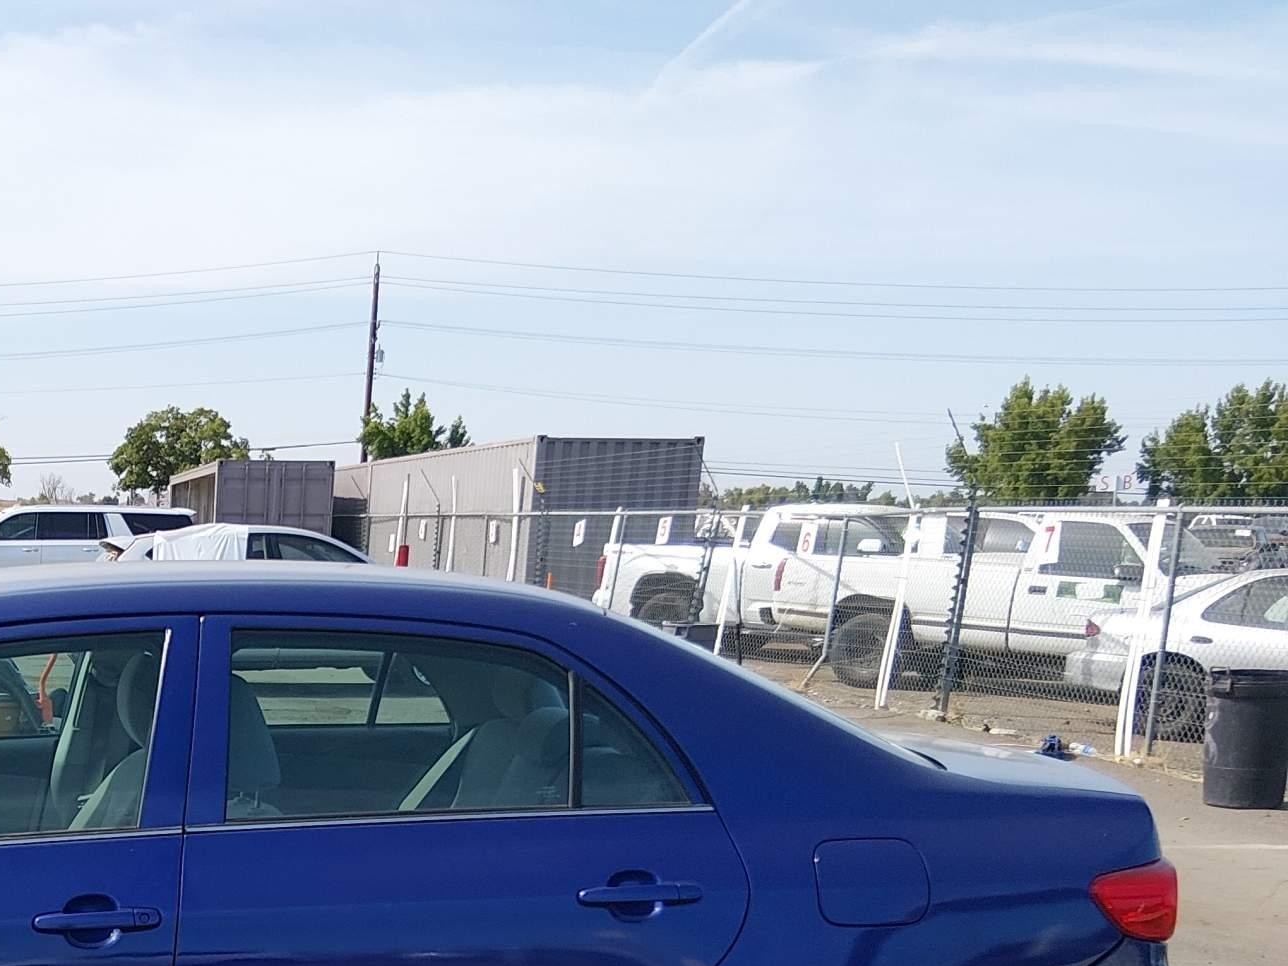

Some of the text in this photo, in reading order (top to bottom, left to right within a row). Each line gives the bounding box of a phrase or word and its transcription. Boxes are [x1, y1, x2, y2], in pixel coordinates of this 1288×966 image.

[1100, 474, 1132, 491] S B
[801, 532, 811, 552] 6
[1044, 525, 1056, 553] 7
